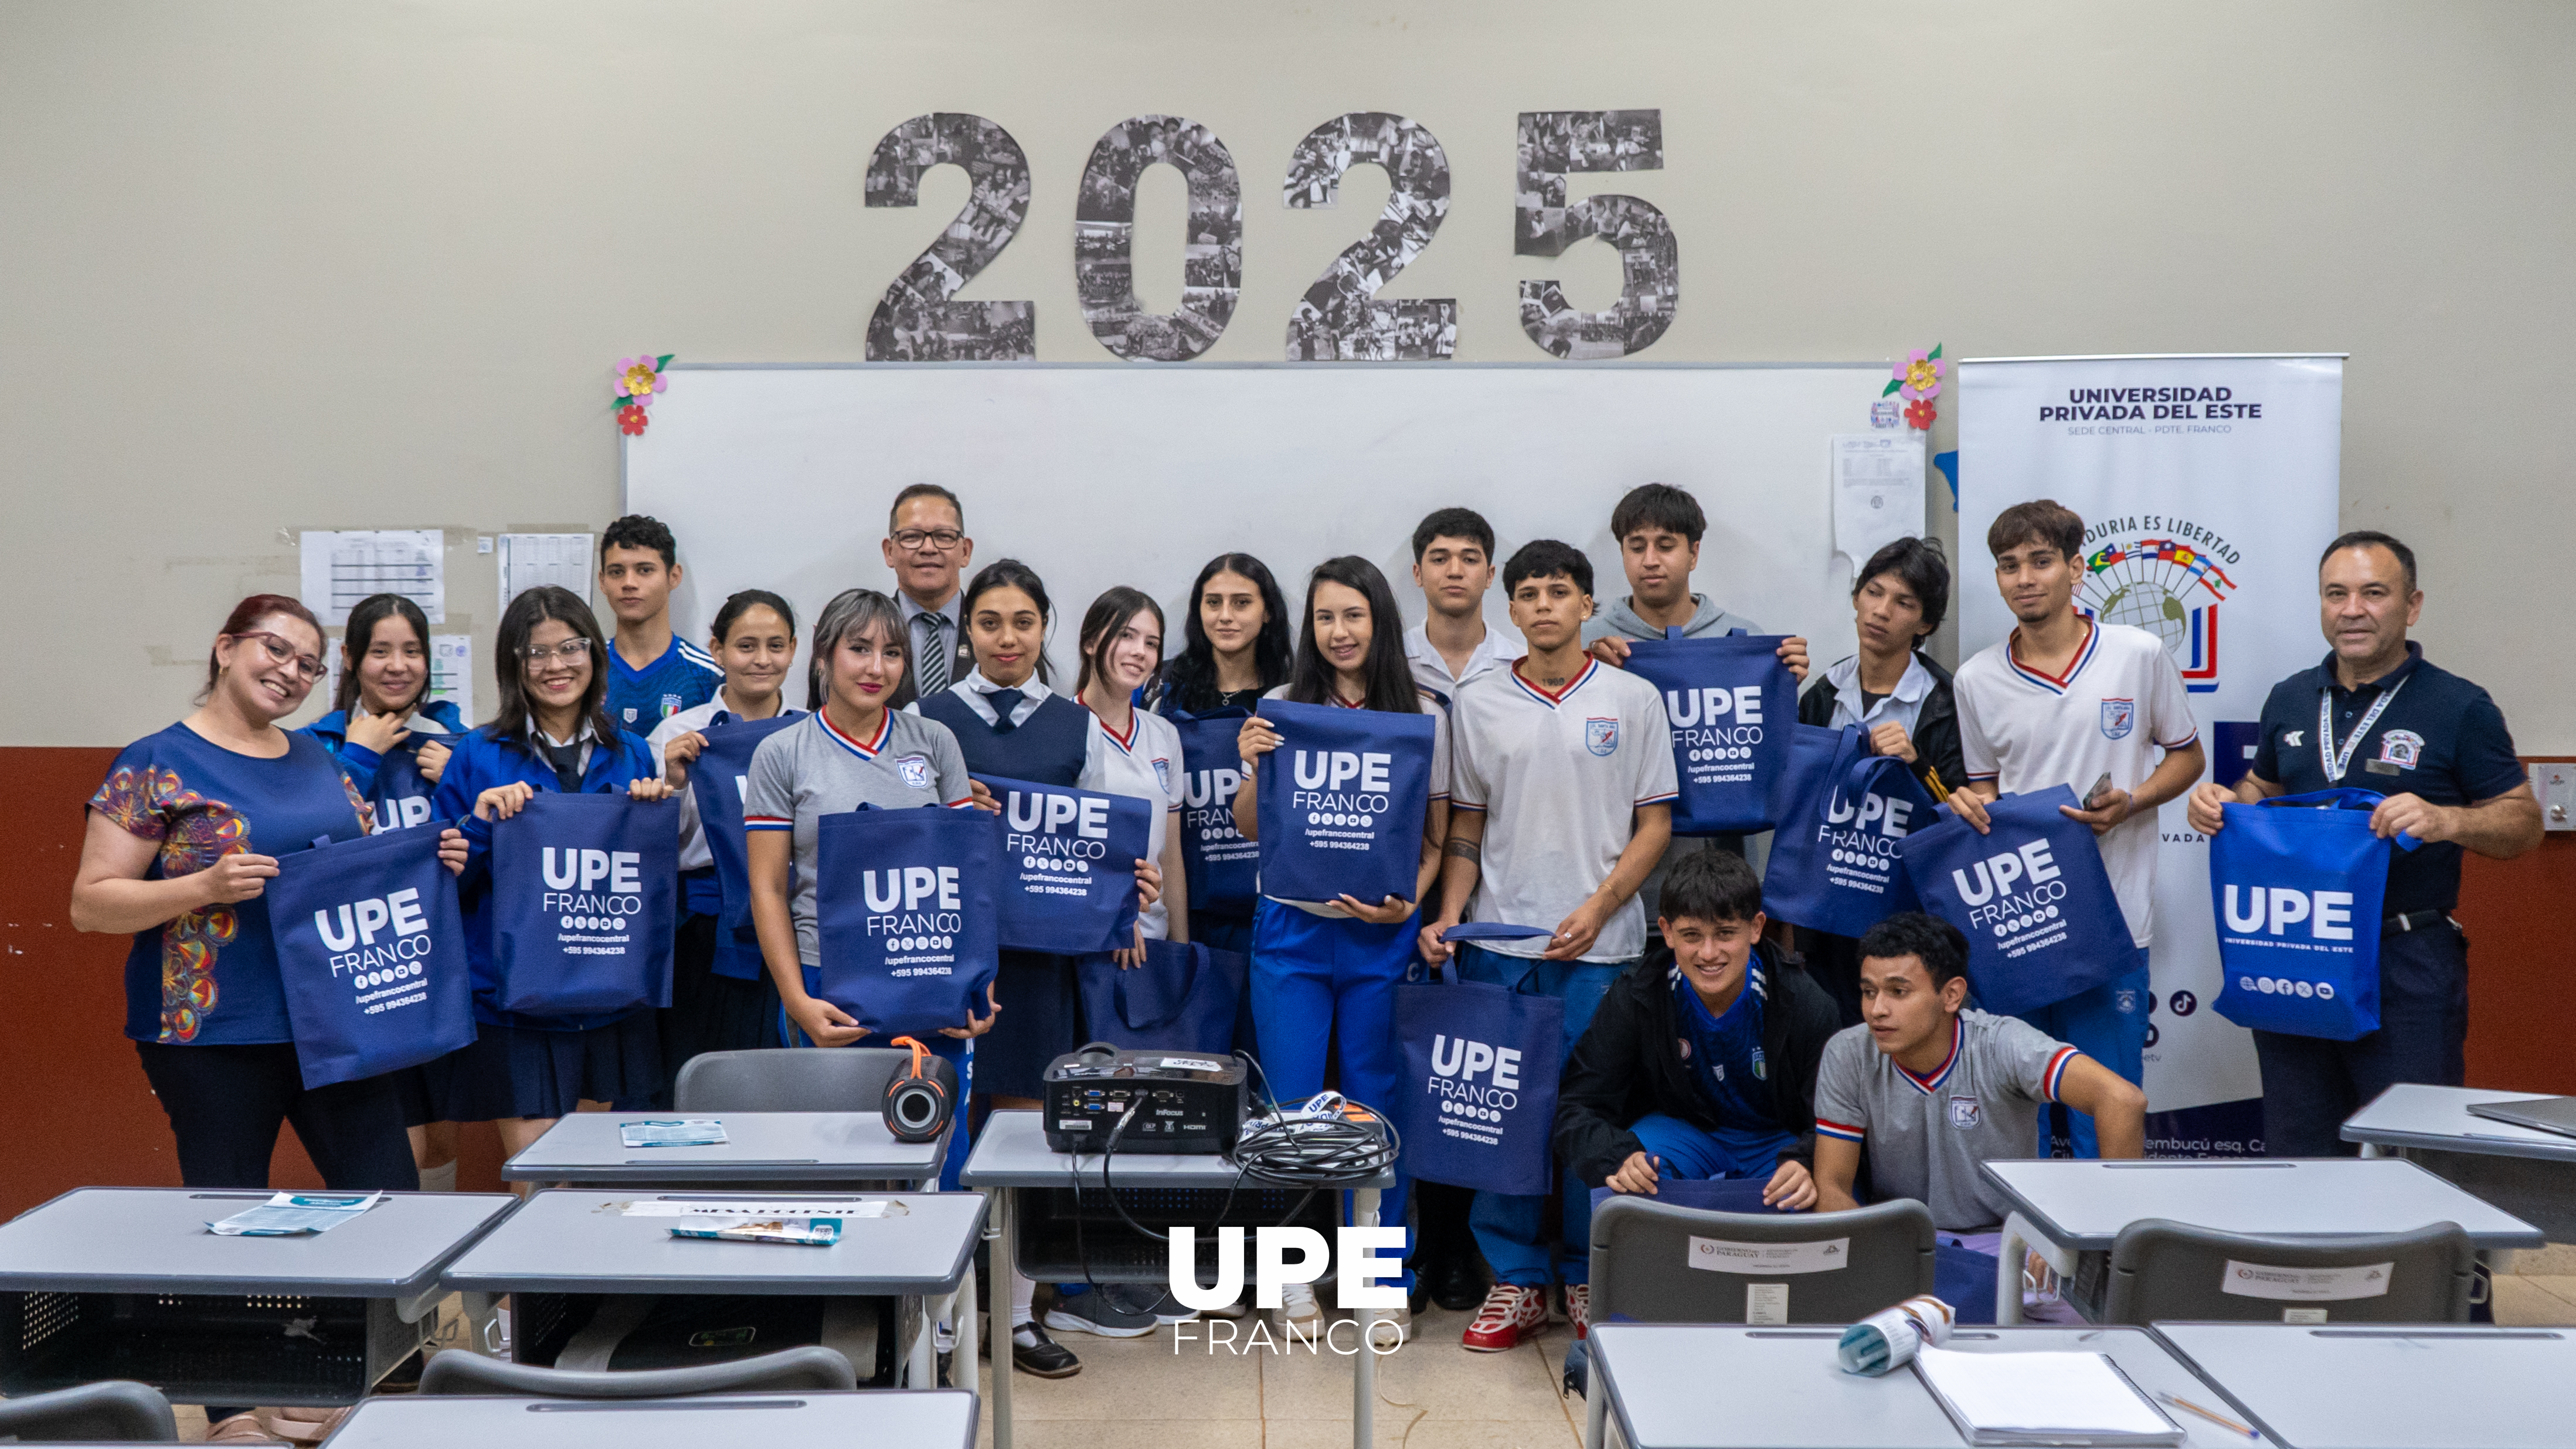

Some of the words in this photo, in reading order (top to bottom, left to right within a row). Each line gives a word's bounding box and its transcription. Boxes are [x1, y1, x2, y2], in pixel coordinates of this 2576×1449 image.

[864, 109, 1680, 362] 2025
[2069, 387, 2232, 403] UNIVERSIDAD
[2040, 405, 2146, 421] PRIVADA
[2153, 404, 2197, 419] DEL
[2205, 403, 2262, 419] ESTE
[2068, 426, 2095, 436] SEDE
[2098, 425, 2146, 435] CENTRAL
[2187, 424, 2231, 434] FRANCO
[2082, 517, 2137, 545] DURIA
[2144, 516, 2161, 530] ES
[2167, 518, 2240, 564] LIBERTAD
[1667, 686, 1763, 728] UPE
[1672, 726, 1763, 748] FRANCO
[1294, 750, 1391, 792] UPE
[1688, 763, 1755, 774] /upefrancocentral
[1713, 774, 1752, 783] 994364238
[1183, 768, 1241, 808] UP
[1293, 791, 1388, 813] FRANCO
[365, 795, 431, 835] UP
[1008, 791, 1110, 839] UPE
[1305, 828, 1375, 839] /upefrancocentral
[2162, 834, 2205, 842] VADA
[1007, 834, 1106, 859] FRANCO
[1330, 842, 1369, 850] 994364238
[542, 847, 641, 893] UPE
[1019, 872, 1092, 885] /upefrancocentral
[1826, 863, 1889, 883] /upefrancocentral
[1952, 838, 2061, 906] UPE
[863, 866, 961, 913] UPE
[1045, 886, 1087, 896] 994364238
[543, 893, 641, 915] FRANCO
[1969, 880, 2067, 930] FRANCO
[2224, 884, 2353, 940] UPE
[314, 887, 429, 952] UPE
[867, 913, 961, 936] FRANCO
[558, 933, 630, 943] /upefrancocentral
[1998, 919, 2067, 950] /upefrancocentral
[2007, 947, 2026, 958] +595
[2026, 932, 2067, 951] 994364238
[329, 934, 431, 978] FRANCO
[2276, 942, 2312, 950] PRIVADA
[885, 954, 954, 966] /upefrancocentral
[891, 968, 911, 977] +595
[913, 967, 952, 976] 994364238
[355, 978, 428, 1004] /upefrancocentral
[363, 1004, 385, 1015] +595
[386, 992, 427, 1010] 994364238
[1432, 1034, 1522, 1090] UPE
[1309, 1094, 1329, 1113] UPE
[1428, 1076, 1517, 1110] FRANCO
[1439, 1115, 1503, 1135] /upefrancocentral
[1443, 1129, 1459, 1137] +595
[1460, 1131, 1498, 1145] 994364238
[2145, 1137, 2210, 1150] embucú
